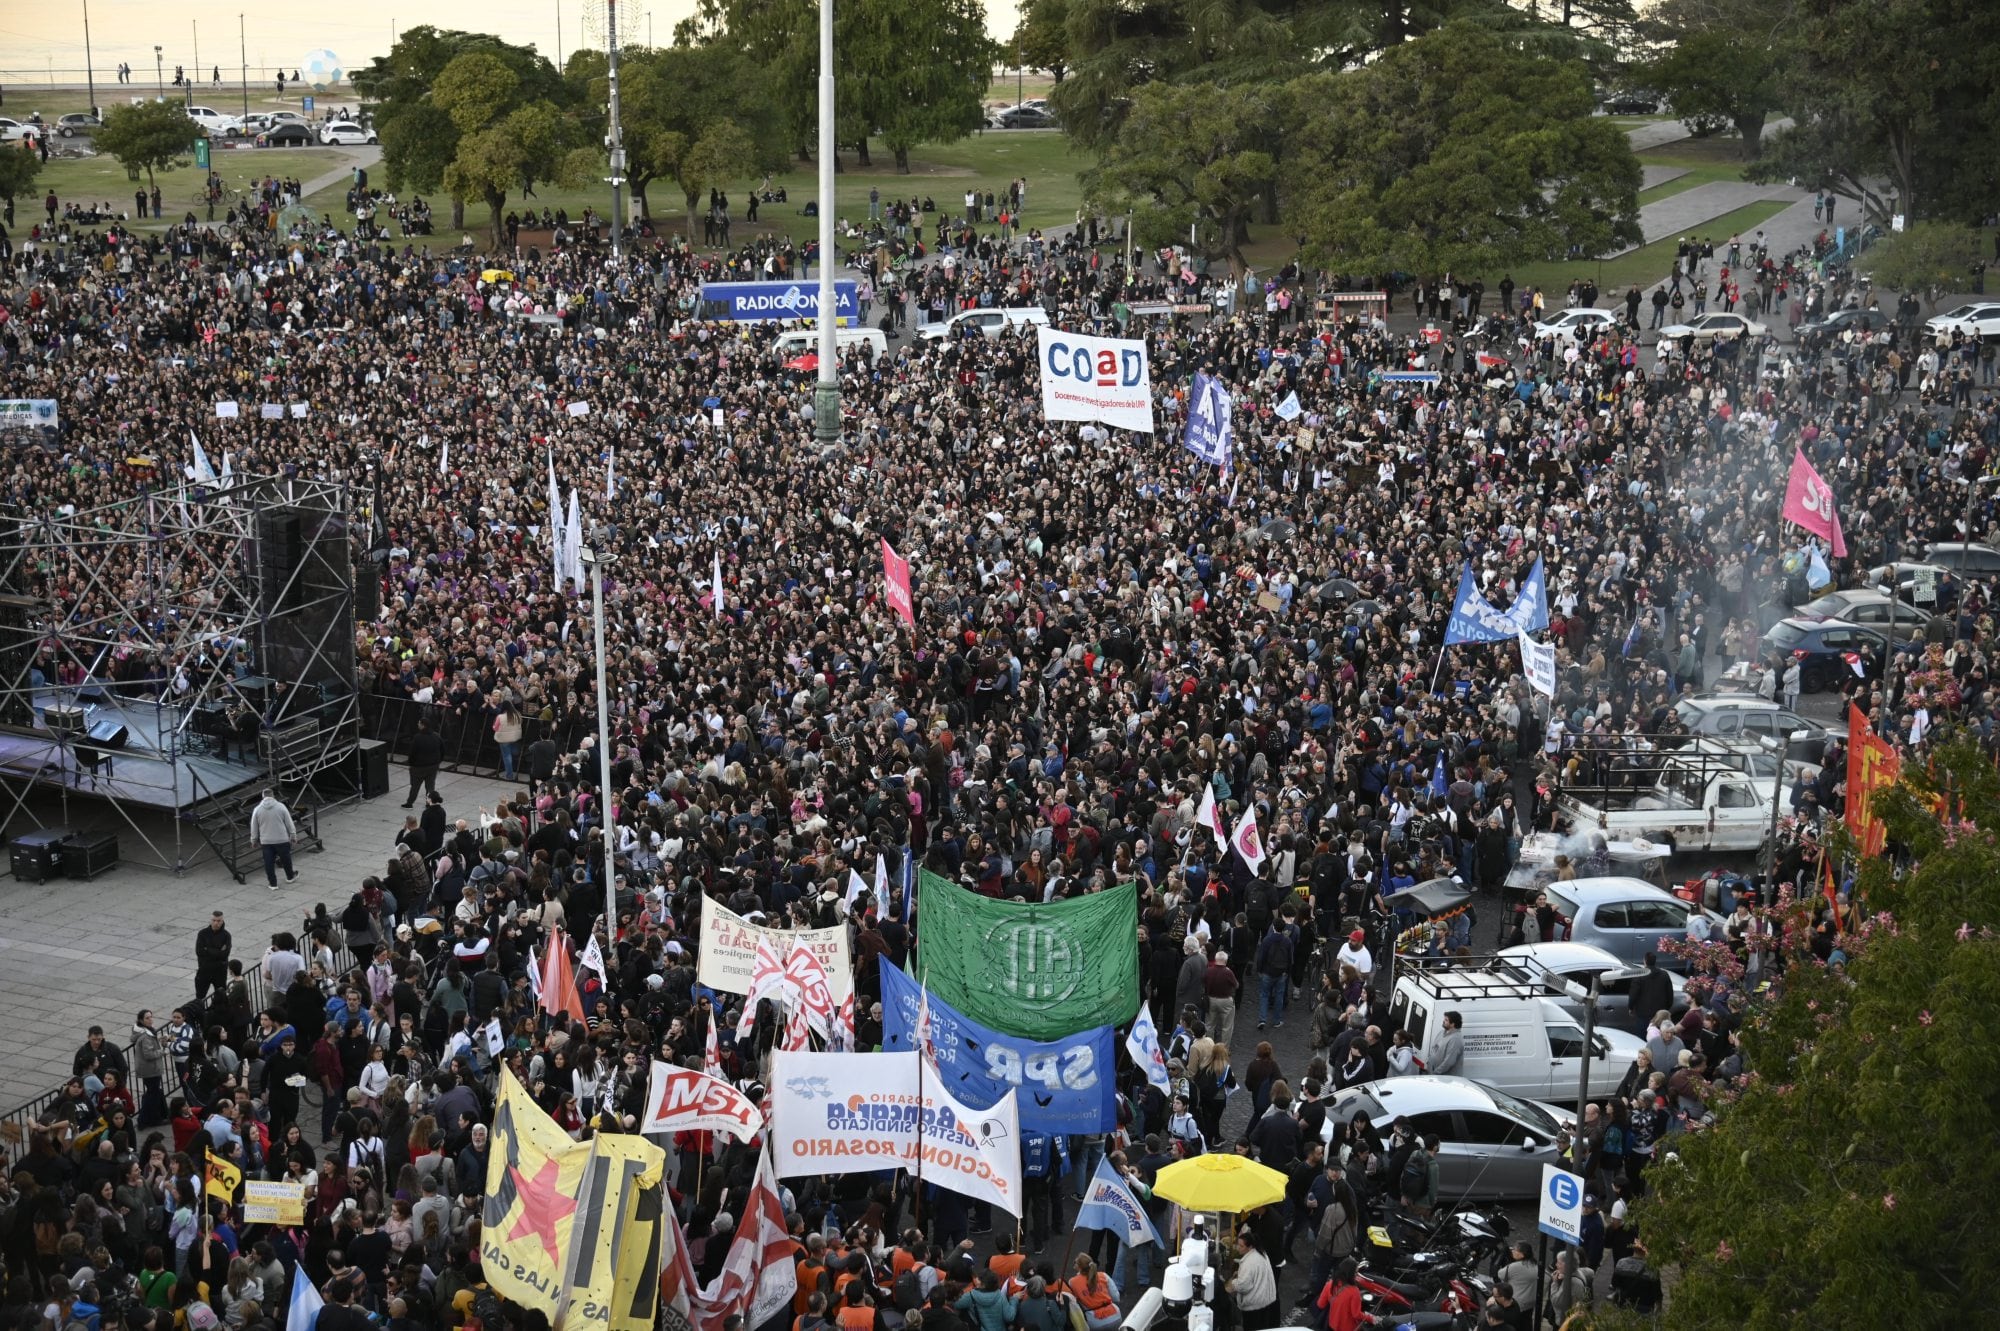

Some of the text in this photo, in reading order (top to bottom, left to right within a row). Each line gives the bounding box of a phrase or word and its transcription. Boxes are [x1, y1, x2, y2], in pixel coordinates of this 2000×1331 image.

[667, 1077, 749, 1113] MST
[1556, 1179, 1572, 1205] E
[1549, 1216, 1575, 1233] MOTOS
